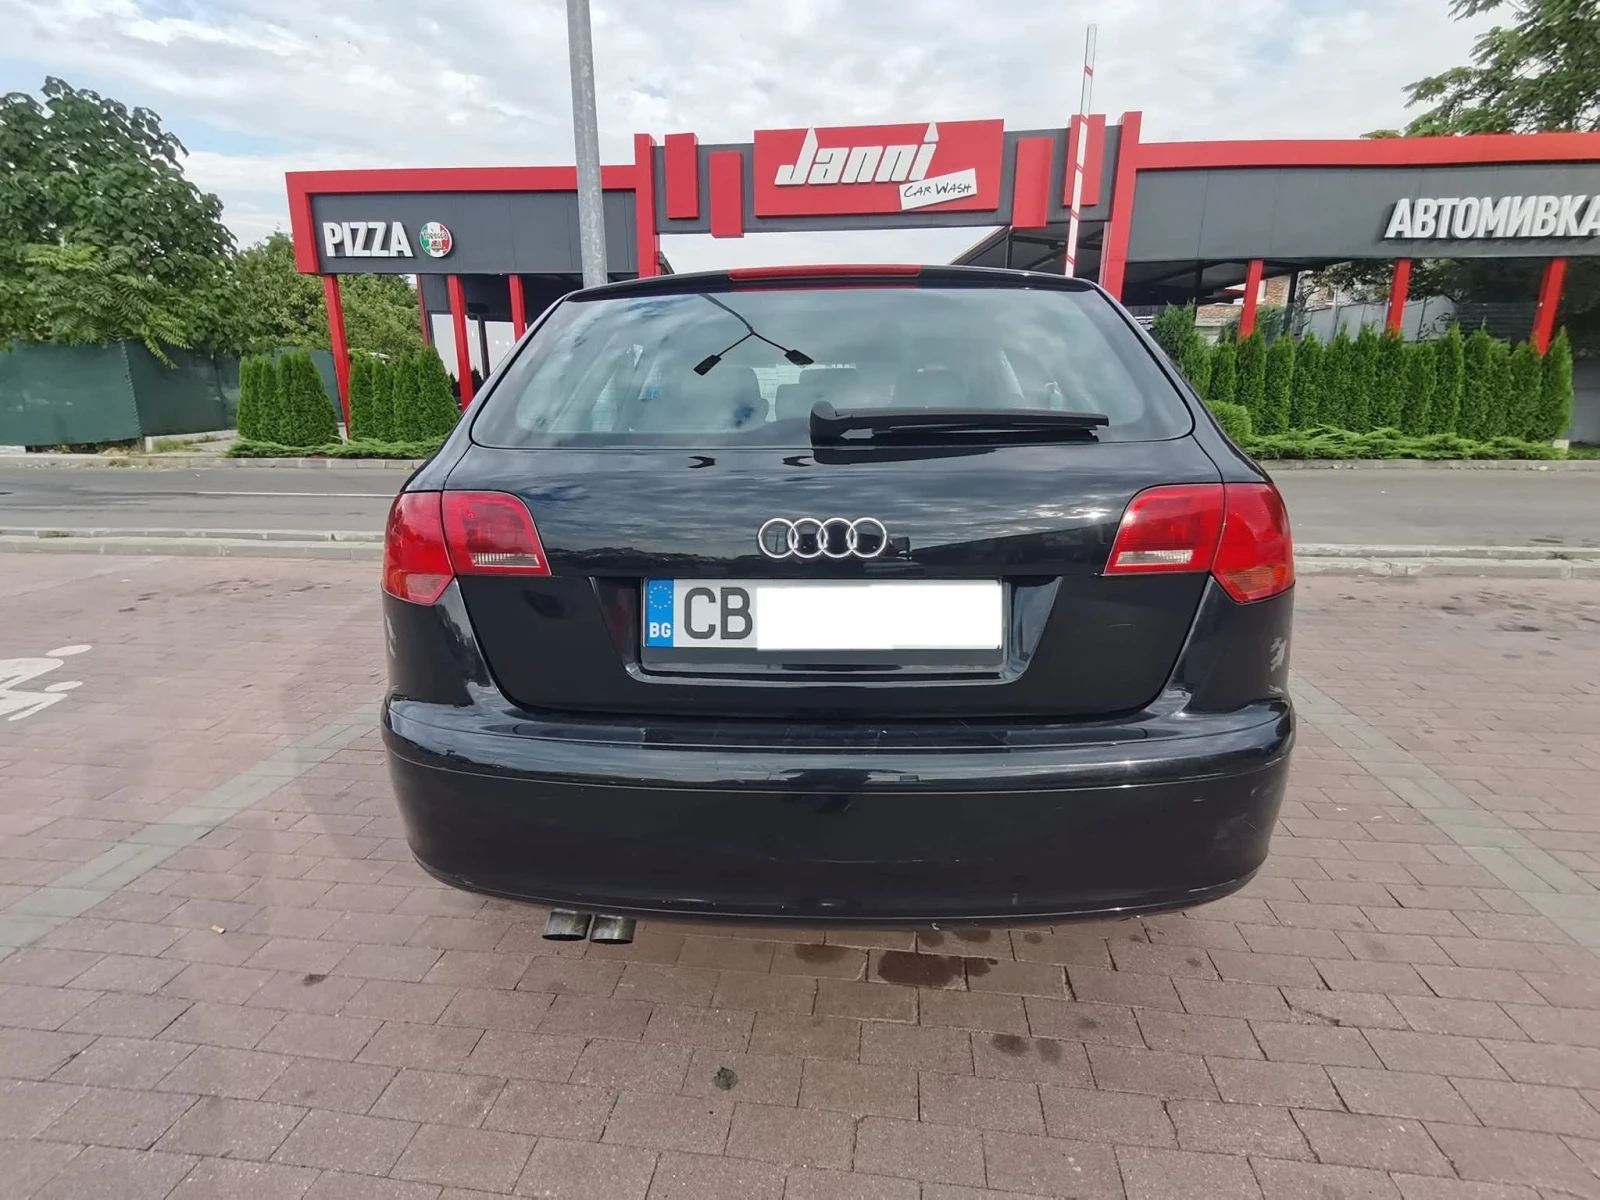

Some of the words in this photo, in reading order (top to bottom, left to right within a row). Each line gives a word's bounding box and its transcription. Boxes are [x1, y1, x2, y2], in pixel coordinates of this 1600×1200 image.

[774, 121, 939, 186] Janni
[903, 184, 931, 198] CAR
[935, 181, 972, 195] WASH
[1384, 194, 1600, 239] АВТОМИВКА
[322, 221, 414, 257] PIZZA
[649, 622, 672, 638] BG
[684, 587, 753, 640] CB
